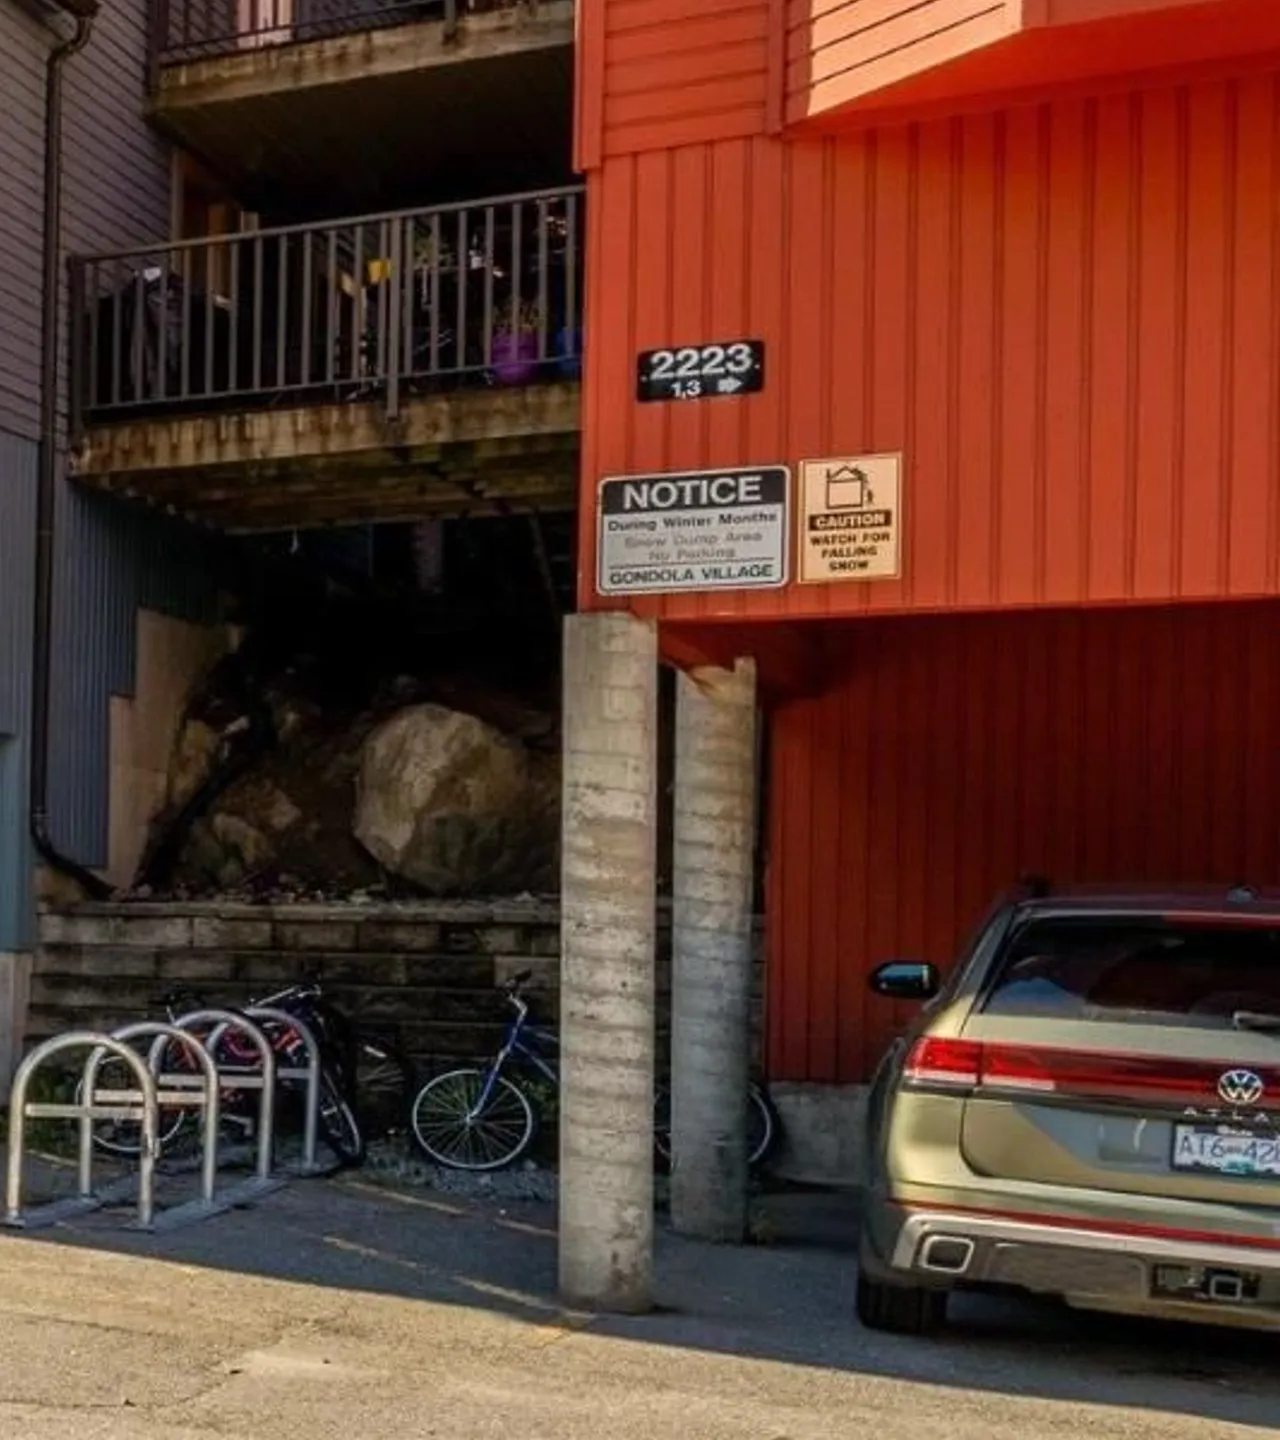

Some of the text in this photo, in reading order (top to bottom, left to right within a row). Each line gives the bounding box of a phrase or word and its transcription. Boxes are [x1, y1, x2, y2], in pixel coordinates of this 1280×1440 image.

[650, 343, 753, 380] 2223
[623, 475, 763, 509] NOTICE
[608, 512, 777, 532] During Winter Months
[816, 513, 885, 528] CAUTION
[810, 532, 890, 546] WATCH FOR
[821, 545, 878, 559] FALLING
[609, 563, 773, 585] GONDOLA VILLAGE
